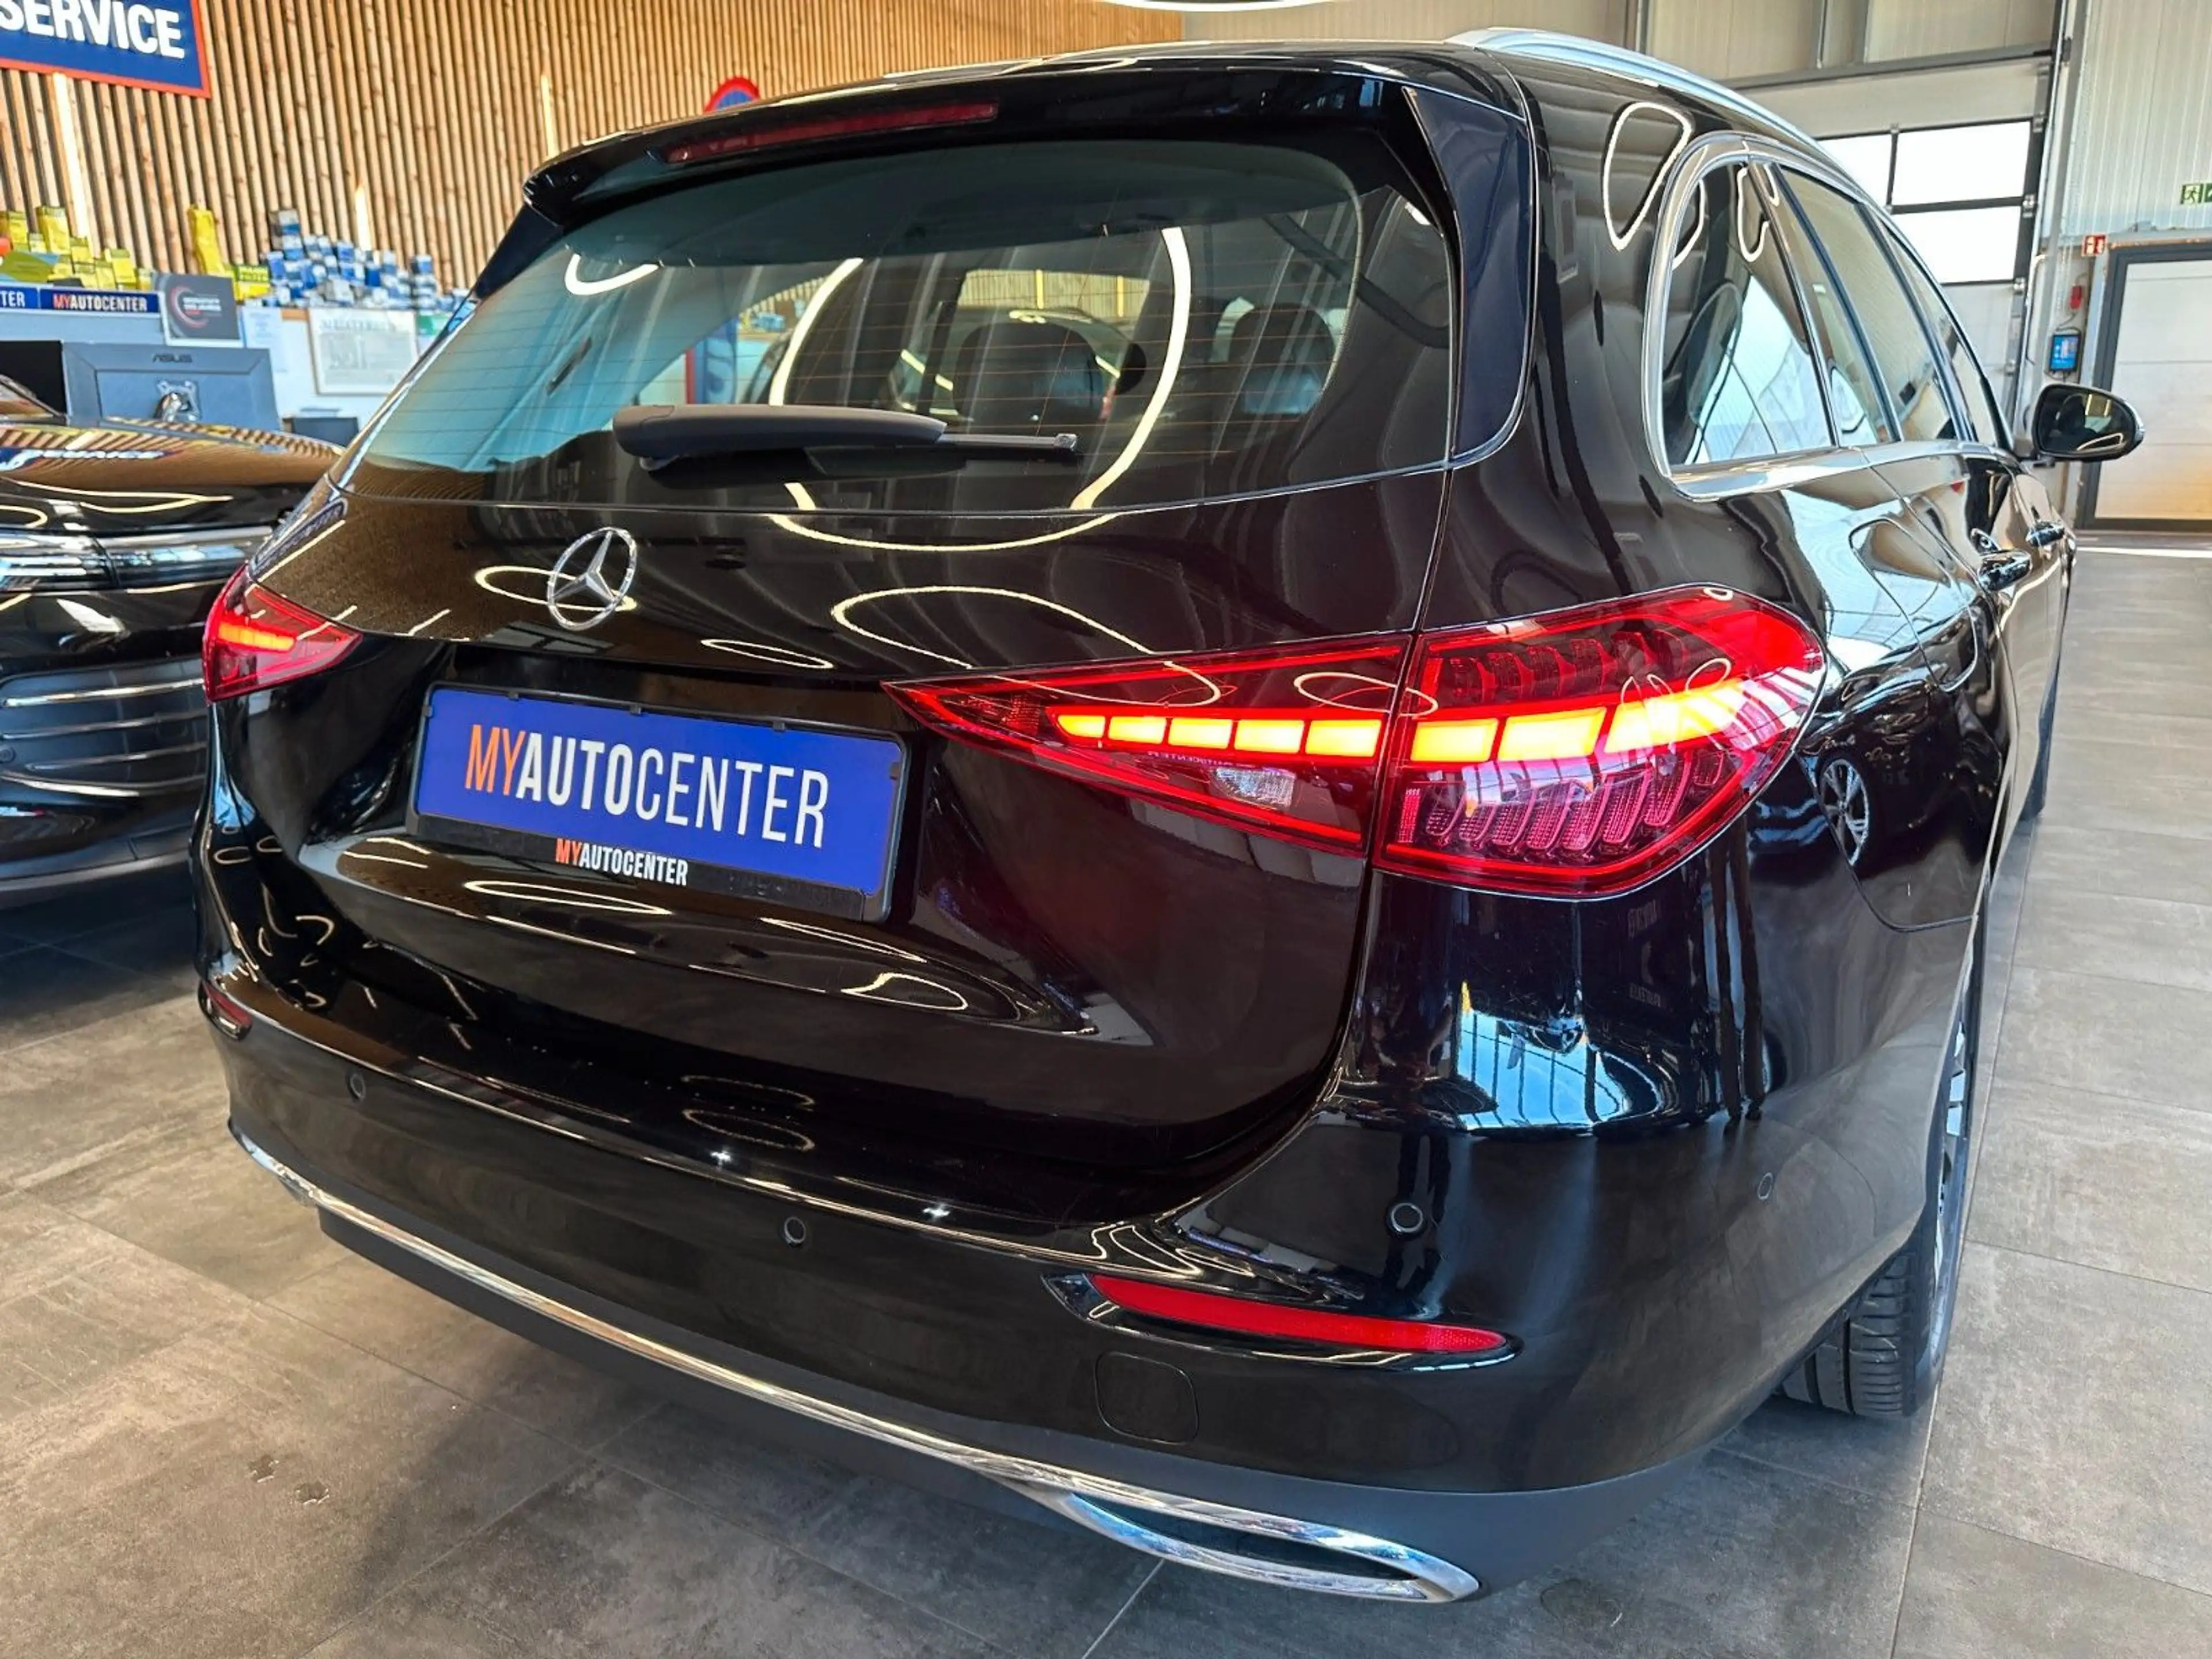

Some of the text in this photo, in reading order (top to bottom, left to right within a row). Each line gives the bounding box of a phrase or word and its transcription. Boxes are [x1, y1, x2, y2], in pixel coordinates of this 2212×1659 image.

[0, 0, 185, 59] SERVICE
[53, 293, 147, 312] MYAUTOCENTER
[465, 724, 829, 848] MYAUTOCENTER
[555, 838, 688, 886] MYAUTOCENTER
